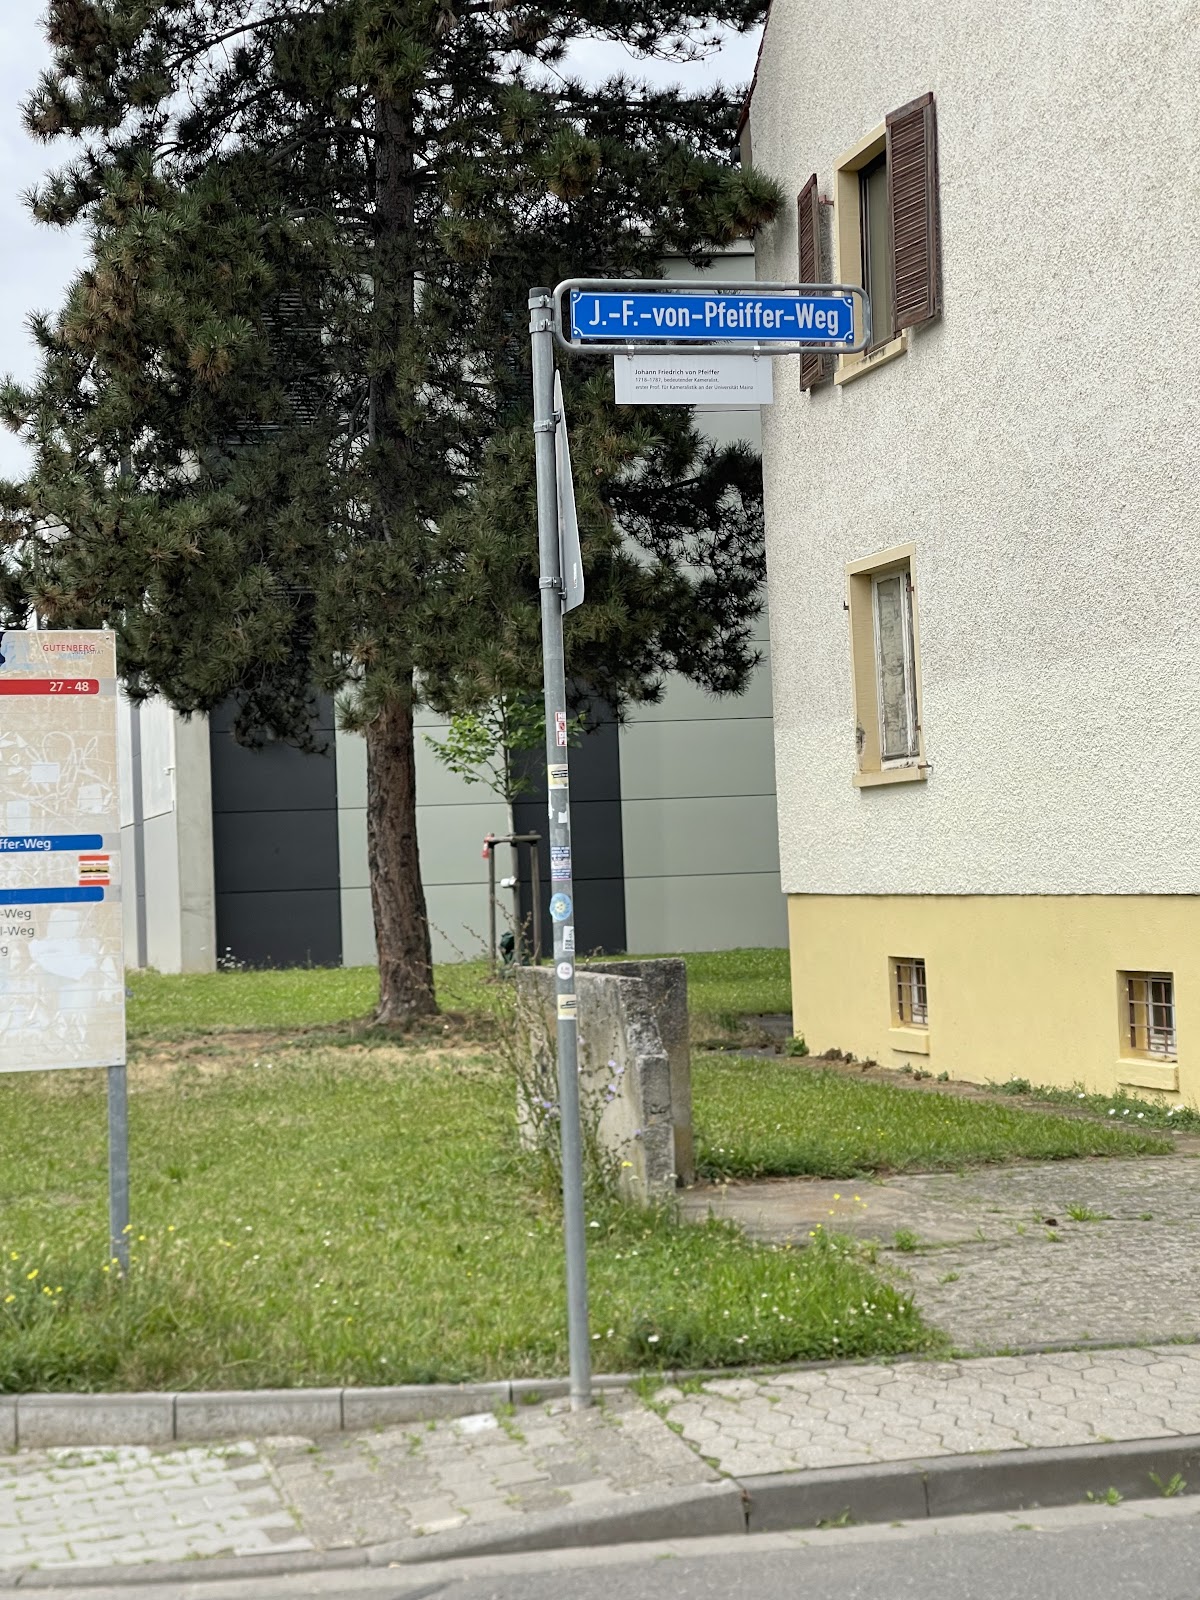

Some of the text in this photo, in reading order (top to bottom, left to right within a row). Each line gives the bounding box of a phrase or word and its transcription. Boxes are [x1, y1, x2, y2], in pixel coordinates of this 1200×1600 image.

[588, 299, 839, 336] J.-F.-von-Pfeiffer-Weg
[42, 644, 96, 652] GUTENBERG
[49, 681, 64, 692] 27
[74, 681, 90, 692] 48
